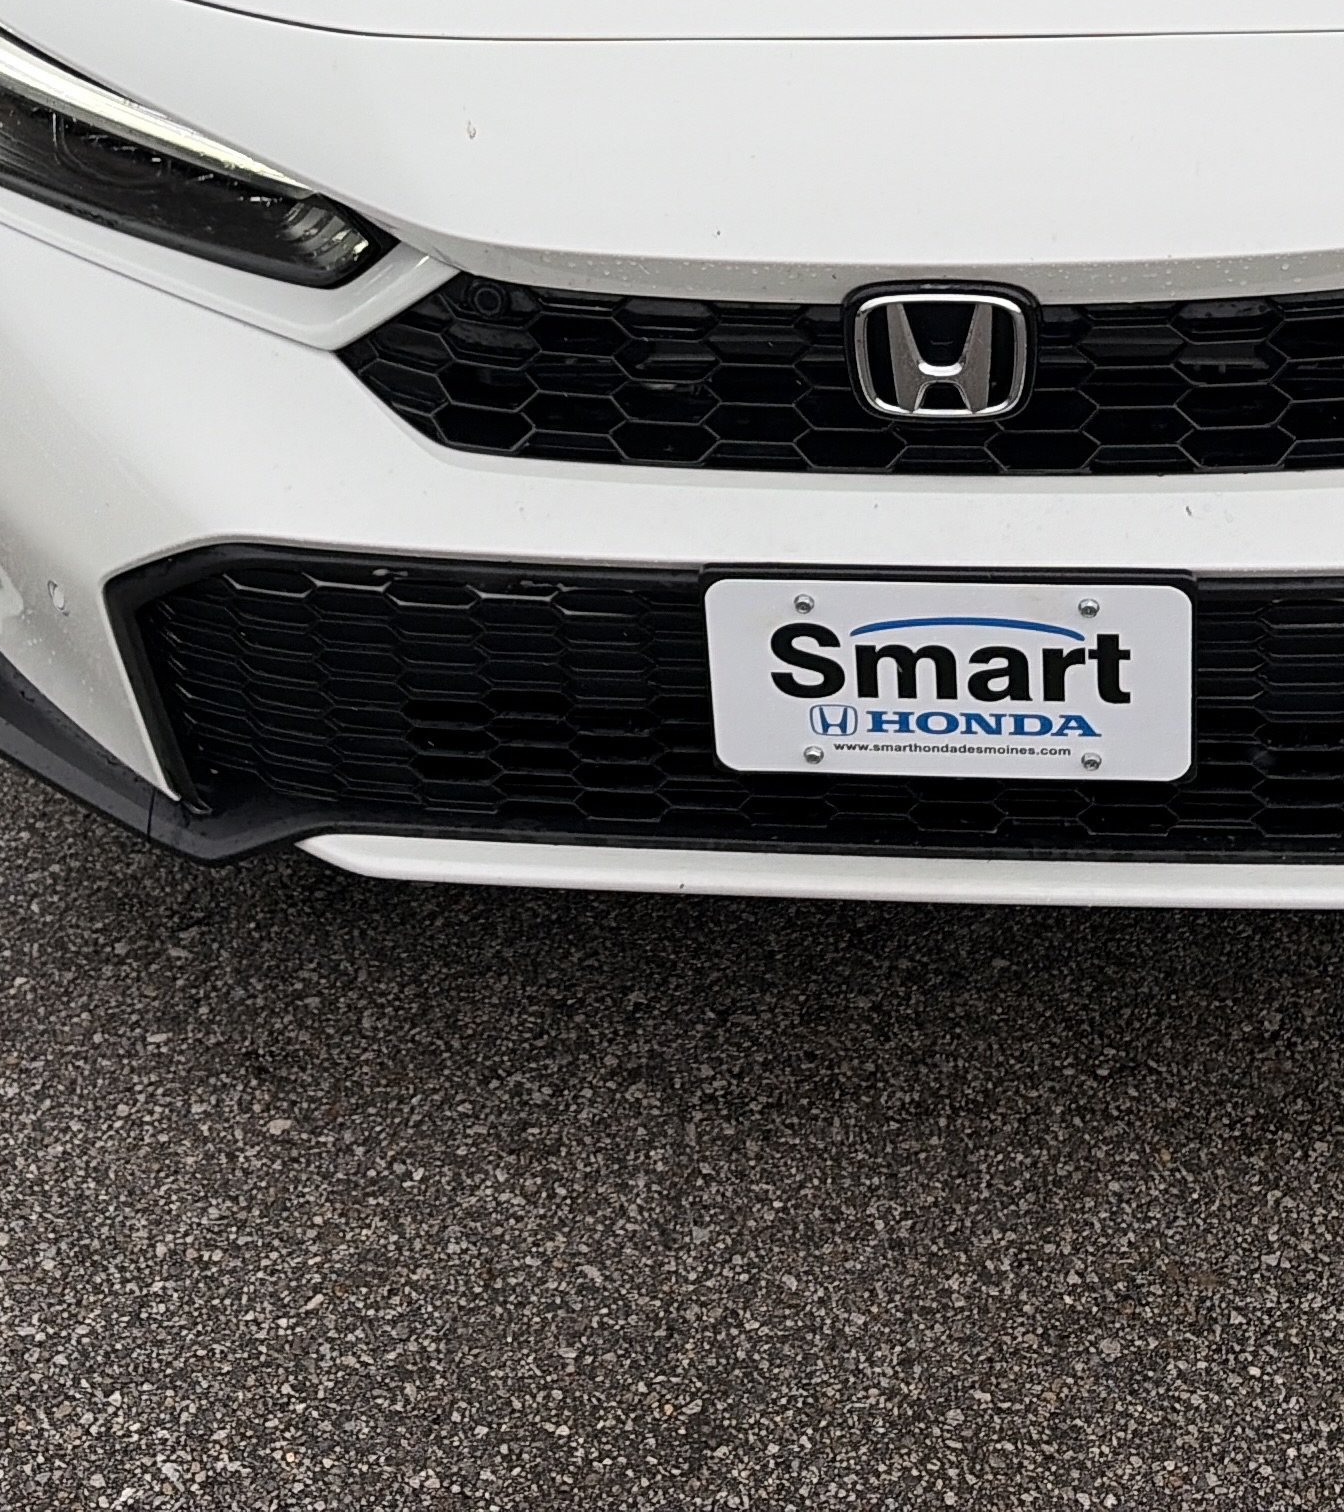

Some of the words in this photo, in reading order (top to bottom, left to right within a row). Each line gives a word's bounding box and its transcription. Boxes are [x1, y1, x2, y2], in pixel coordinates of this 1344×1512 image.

[770, 622, 1132, 705] Smart
[866, 710, 1101, 738] HONDA
[833, 741, 1072, 758] www.smarthondadesmoines.com
